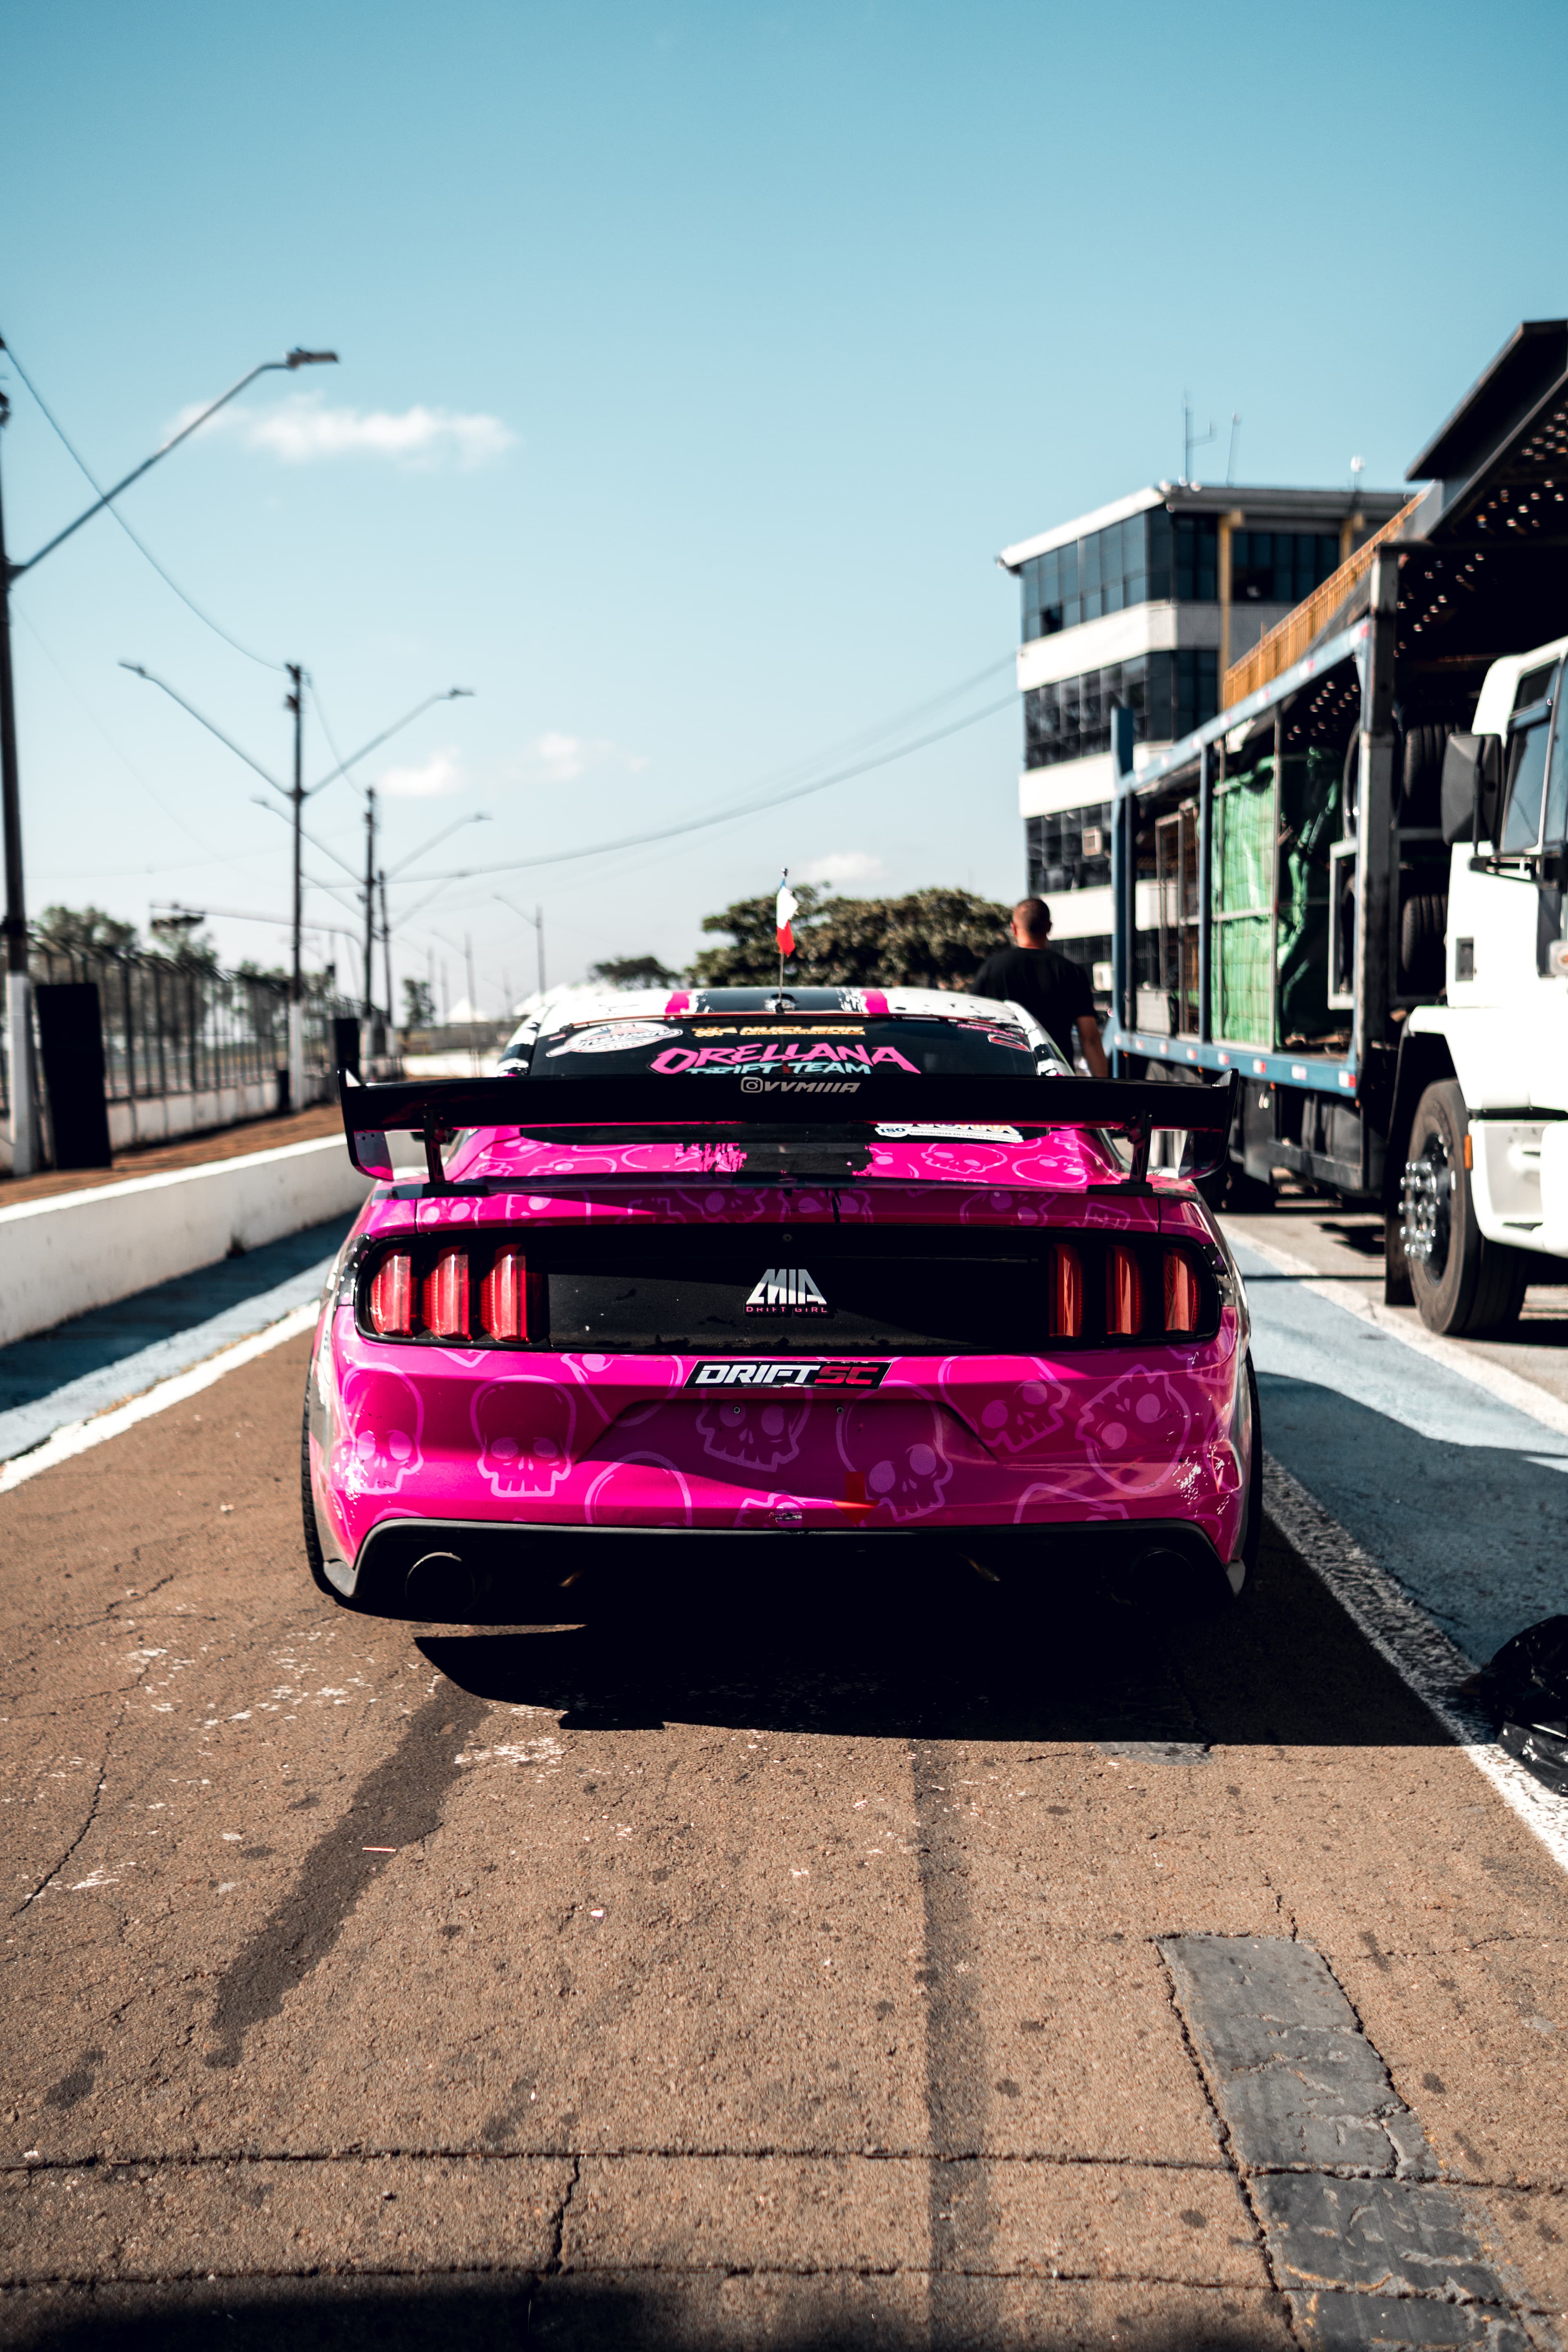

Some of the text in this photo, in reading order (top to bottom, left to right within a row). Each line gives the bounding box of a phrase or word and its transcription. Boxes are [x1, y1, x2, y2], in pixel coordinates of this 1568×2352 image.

[740, 1026, 865, 1034] NUCLEAR
[650, 1043, 922, 1074] ORELLANA
[788, 1062, 871, 1074] TEAM
[746, 1269, 827, 1305] MIA
